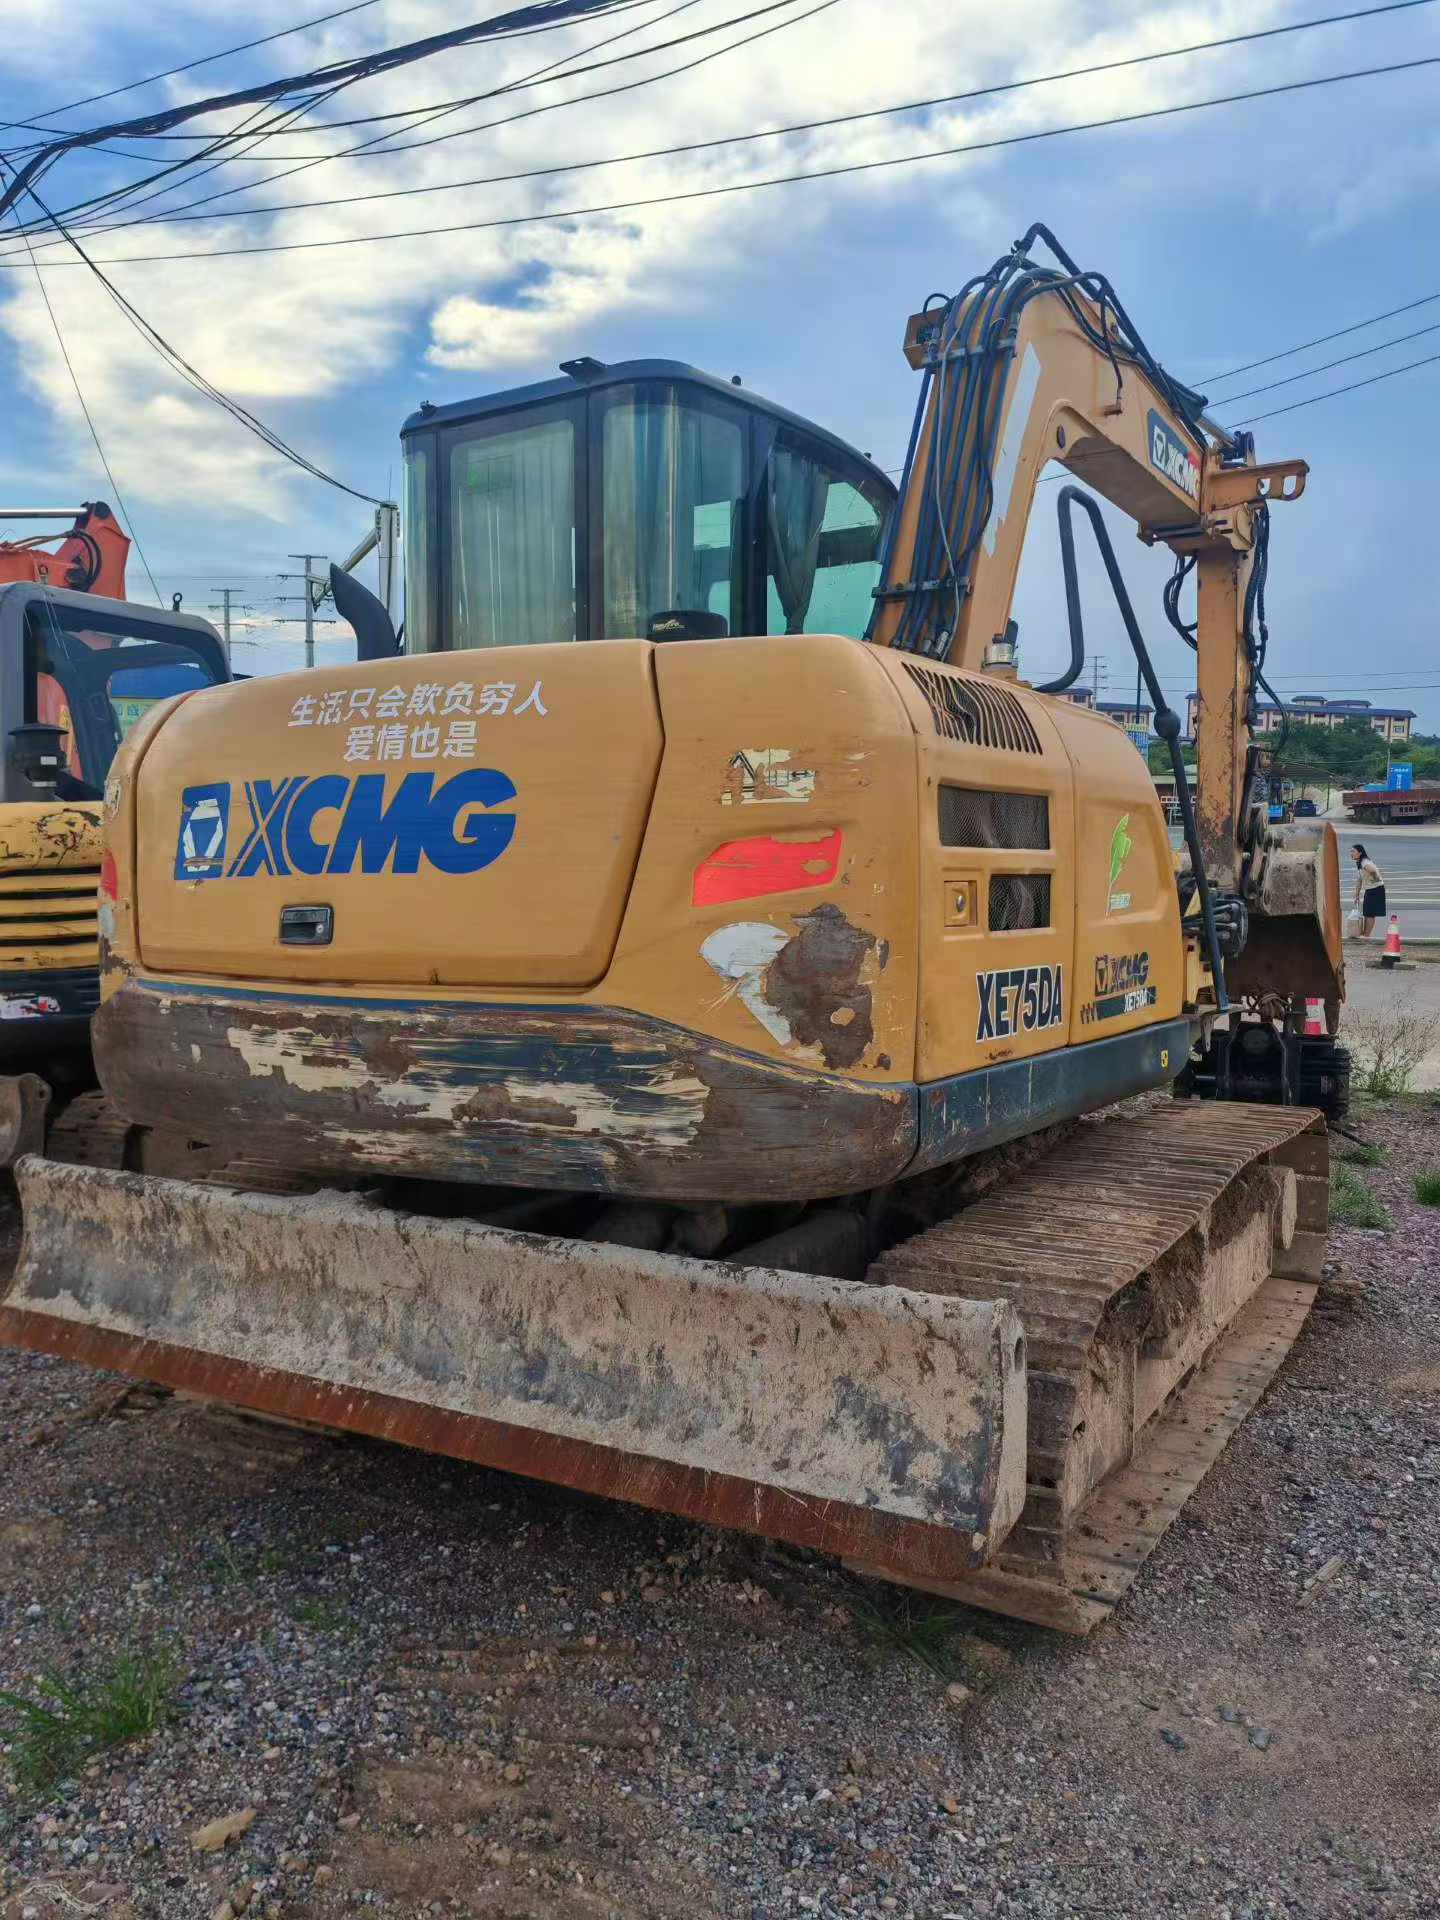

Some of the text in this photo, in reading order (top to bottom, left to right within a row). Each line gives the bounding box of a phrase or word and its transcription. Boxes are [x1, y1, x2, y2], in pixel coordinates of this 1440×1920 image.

[288, 680, 549, 727] 生活只会欺负穷人
[343, 720, 479, 762] 爱情也是
[227, 768, 517, 876] XCMG
[975, 963, 1063, 1043] XE75DA
